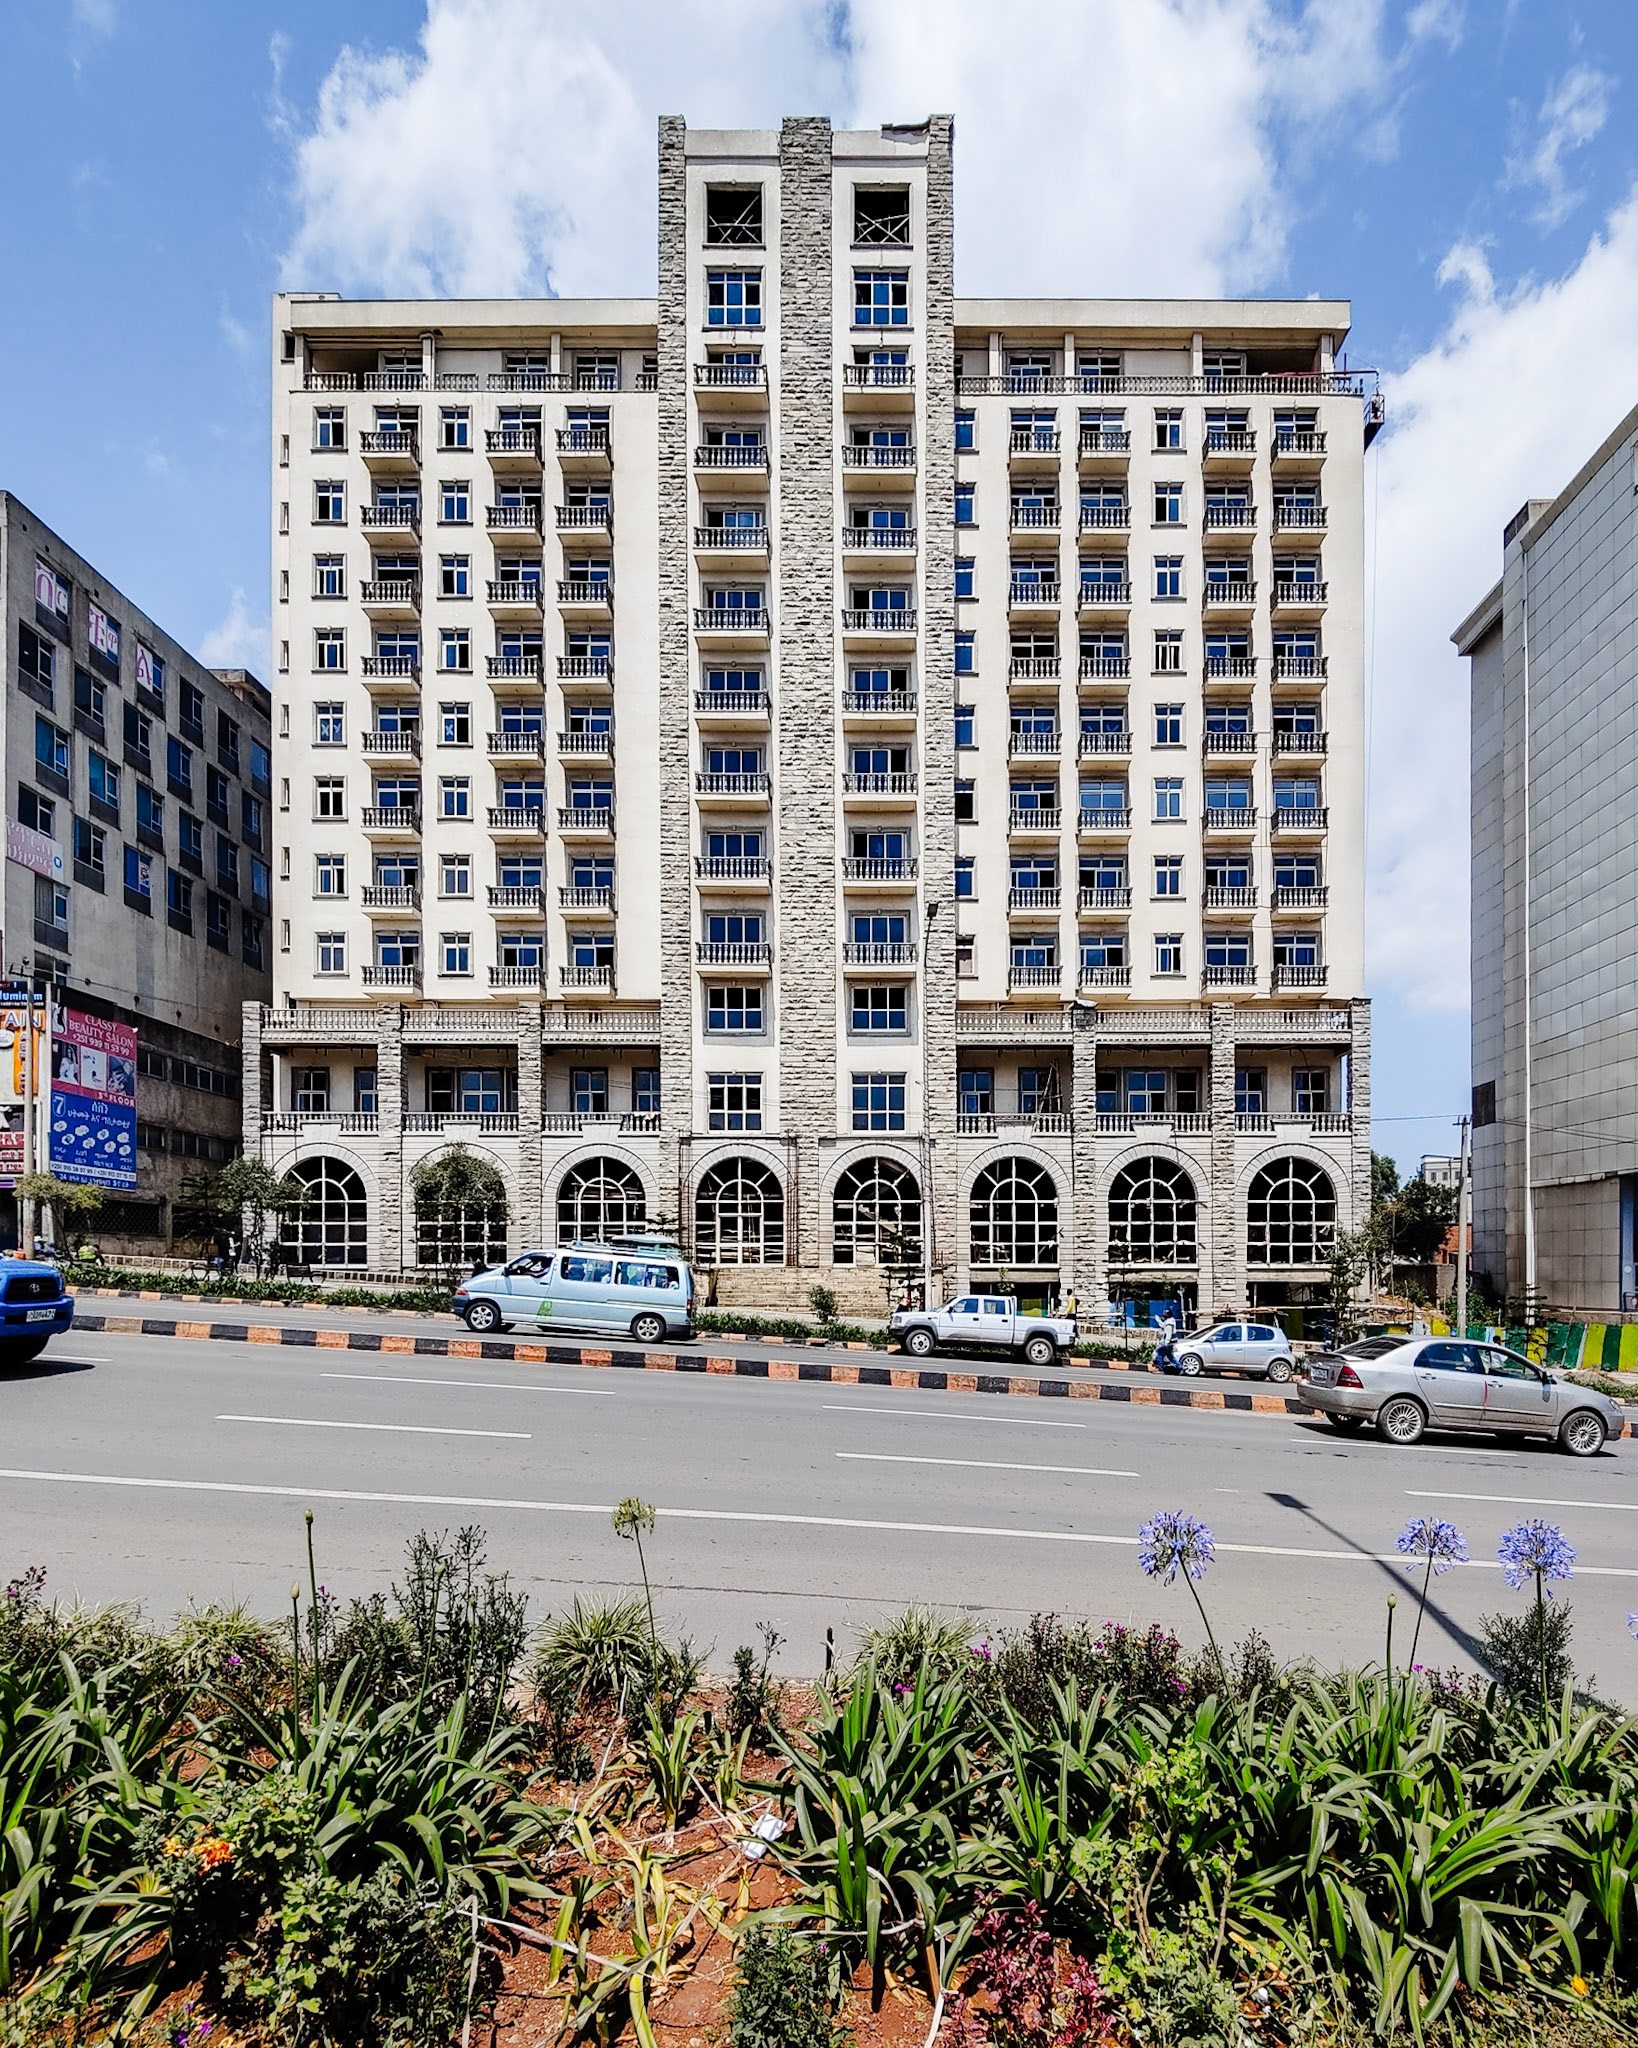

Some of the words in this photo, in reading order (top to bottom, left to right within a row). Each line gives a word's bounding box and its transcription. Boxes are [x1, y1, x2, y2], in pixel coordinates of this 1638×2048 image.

[85, 1014, 117, 1032] CLASSY
[69, 1020, 104, 1039] BEAUTY
[105, 1032, 134, 1049] SALON
[73, 1033, 88, 1044] +251
[89, 1037, 103, 1049] 939
[111, 1044, 119, 1053] 53
[109, 1093, 135, 1107] FLOOR
